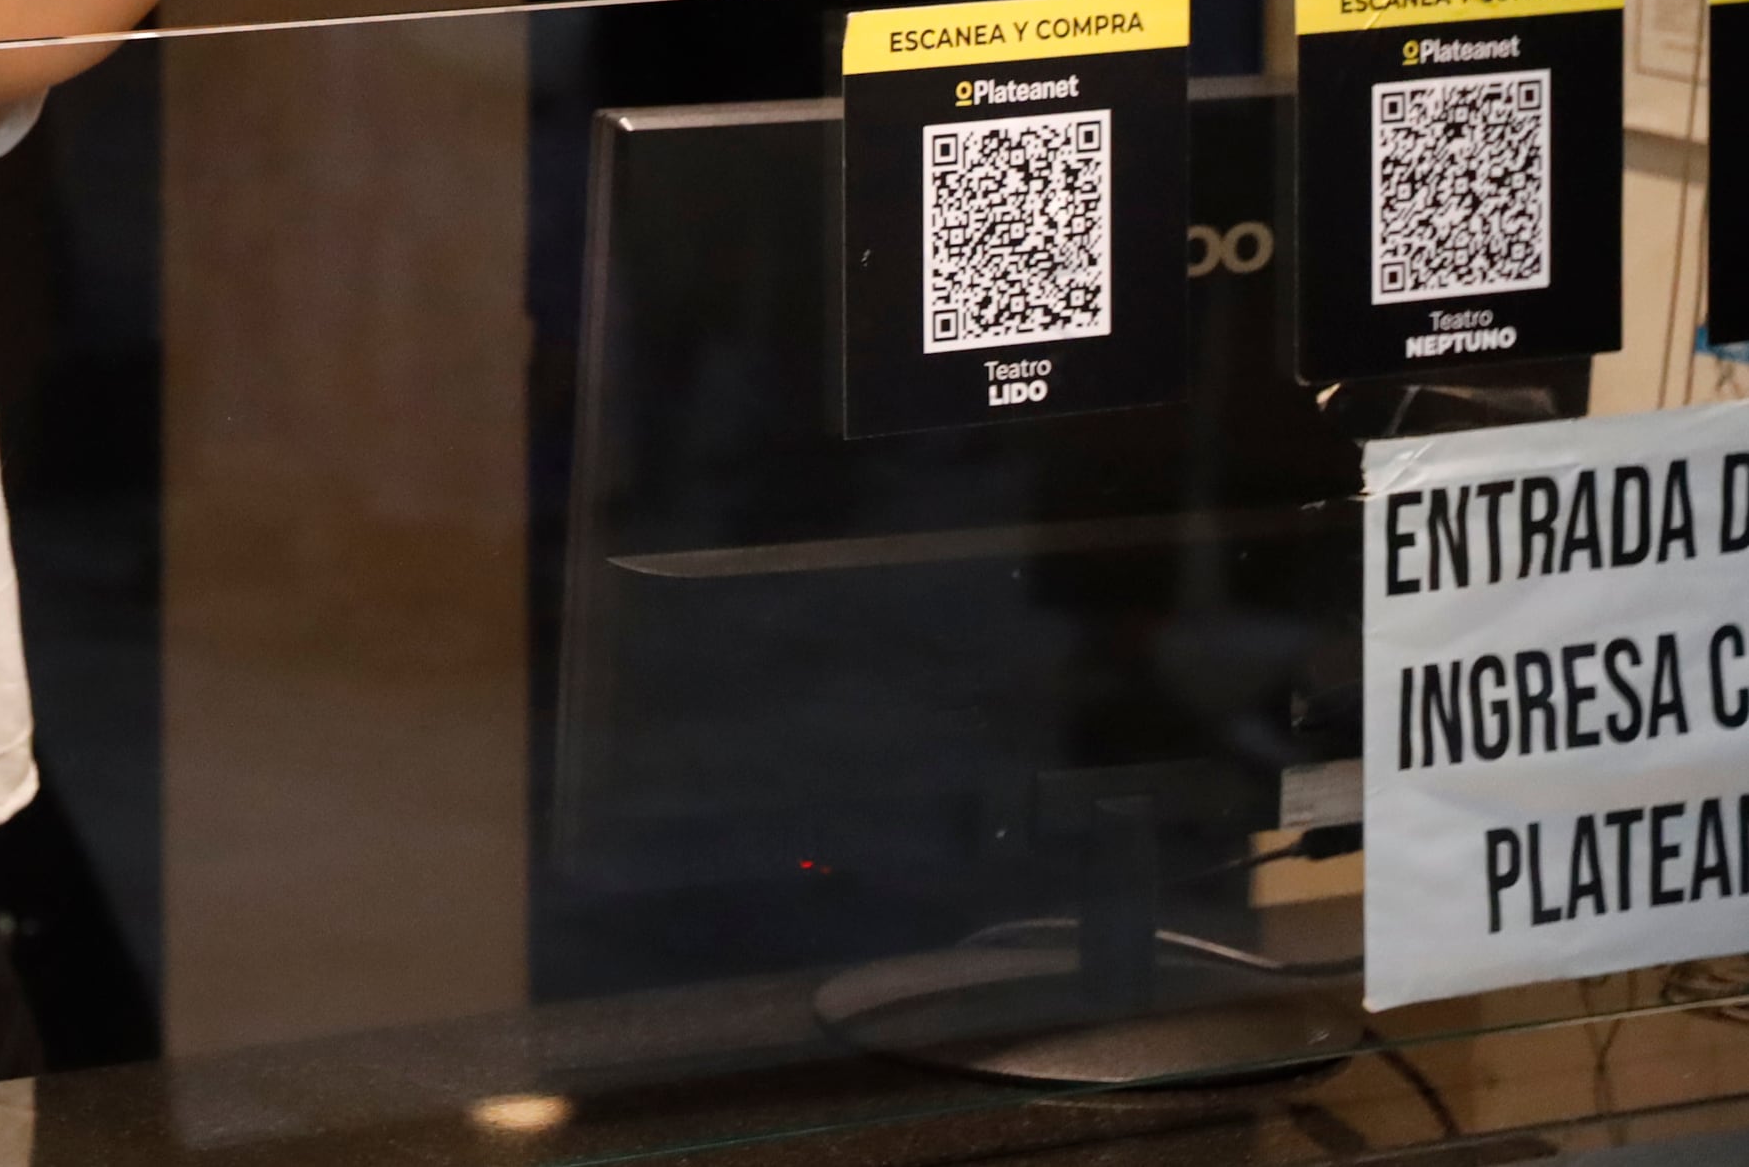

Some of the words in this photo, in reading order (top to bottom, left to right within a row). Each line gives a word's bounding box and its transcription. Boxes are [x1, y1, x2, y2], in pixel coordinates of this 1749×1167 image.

[889, 23, 1006, 54] ESCANEA
[1013, 21, 1029, 44] Y
[1036, 12, 1144, 41] COMPRA
[1429, 310, 1493, 332] Teatro
[1406, 327, 1517, 358] NEPTUNO
[984, 359, 1051, 382] Teatro
[989, 380, 1048, 407] LIDO
[1386, 459, 1696, 597] ENTRADA
[1398, 633, 1688, 771] INGRESA
